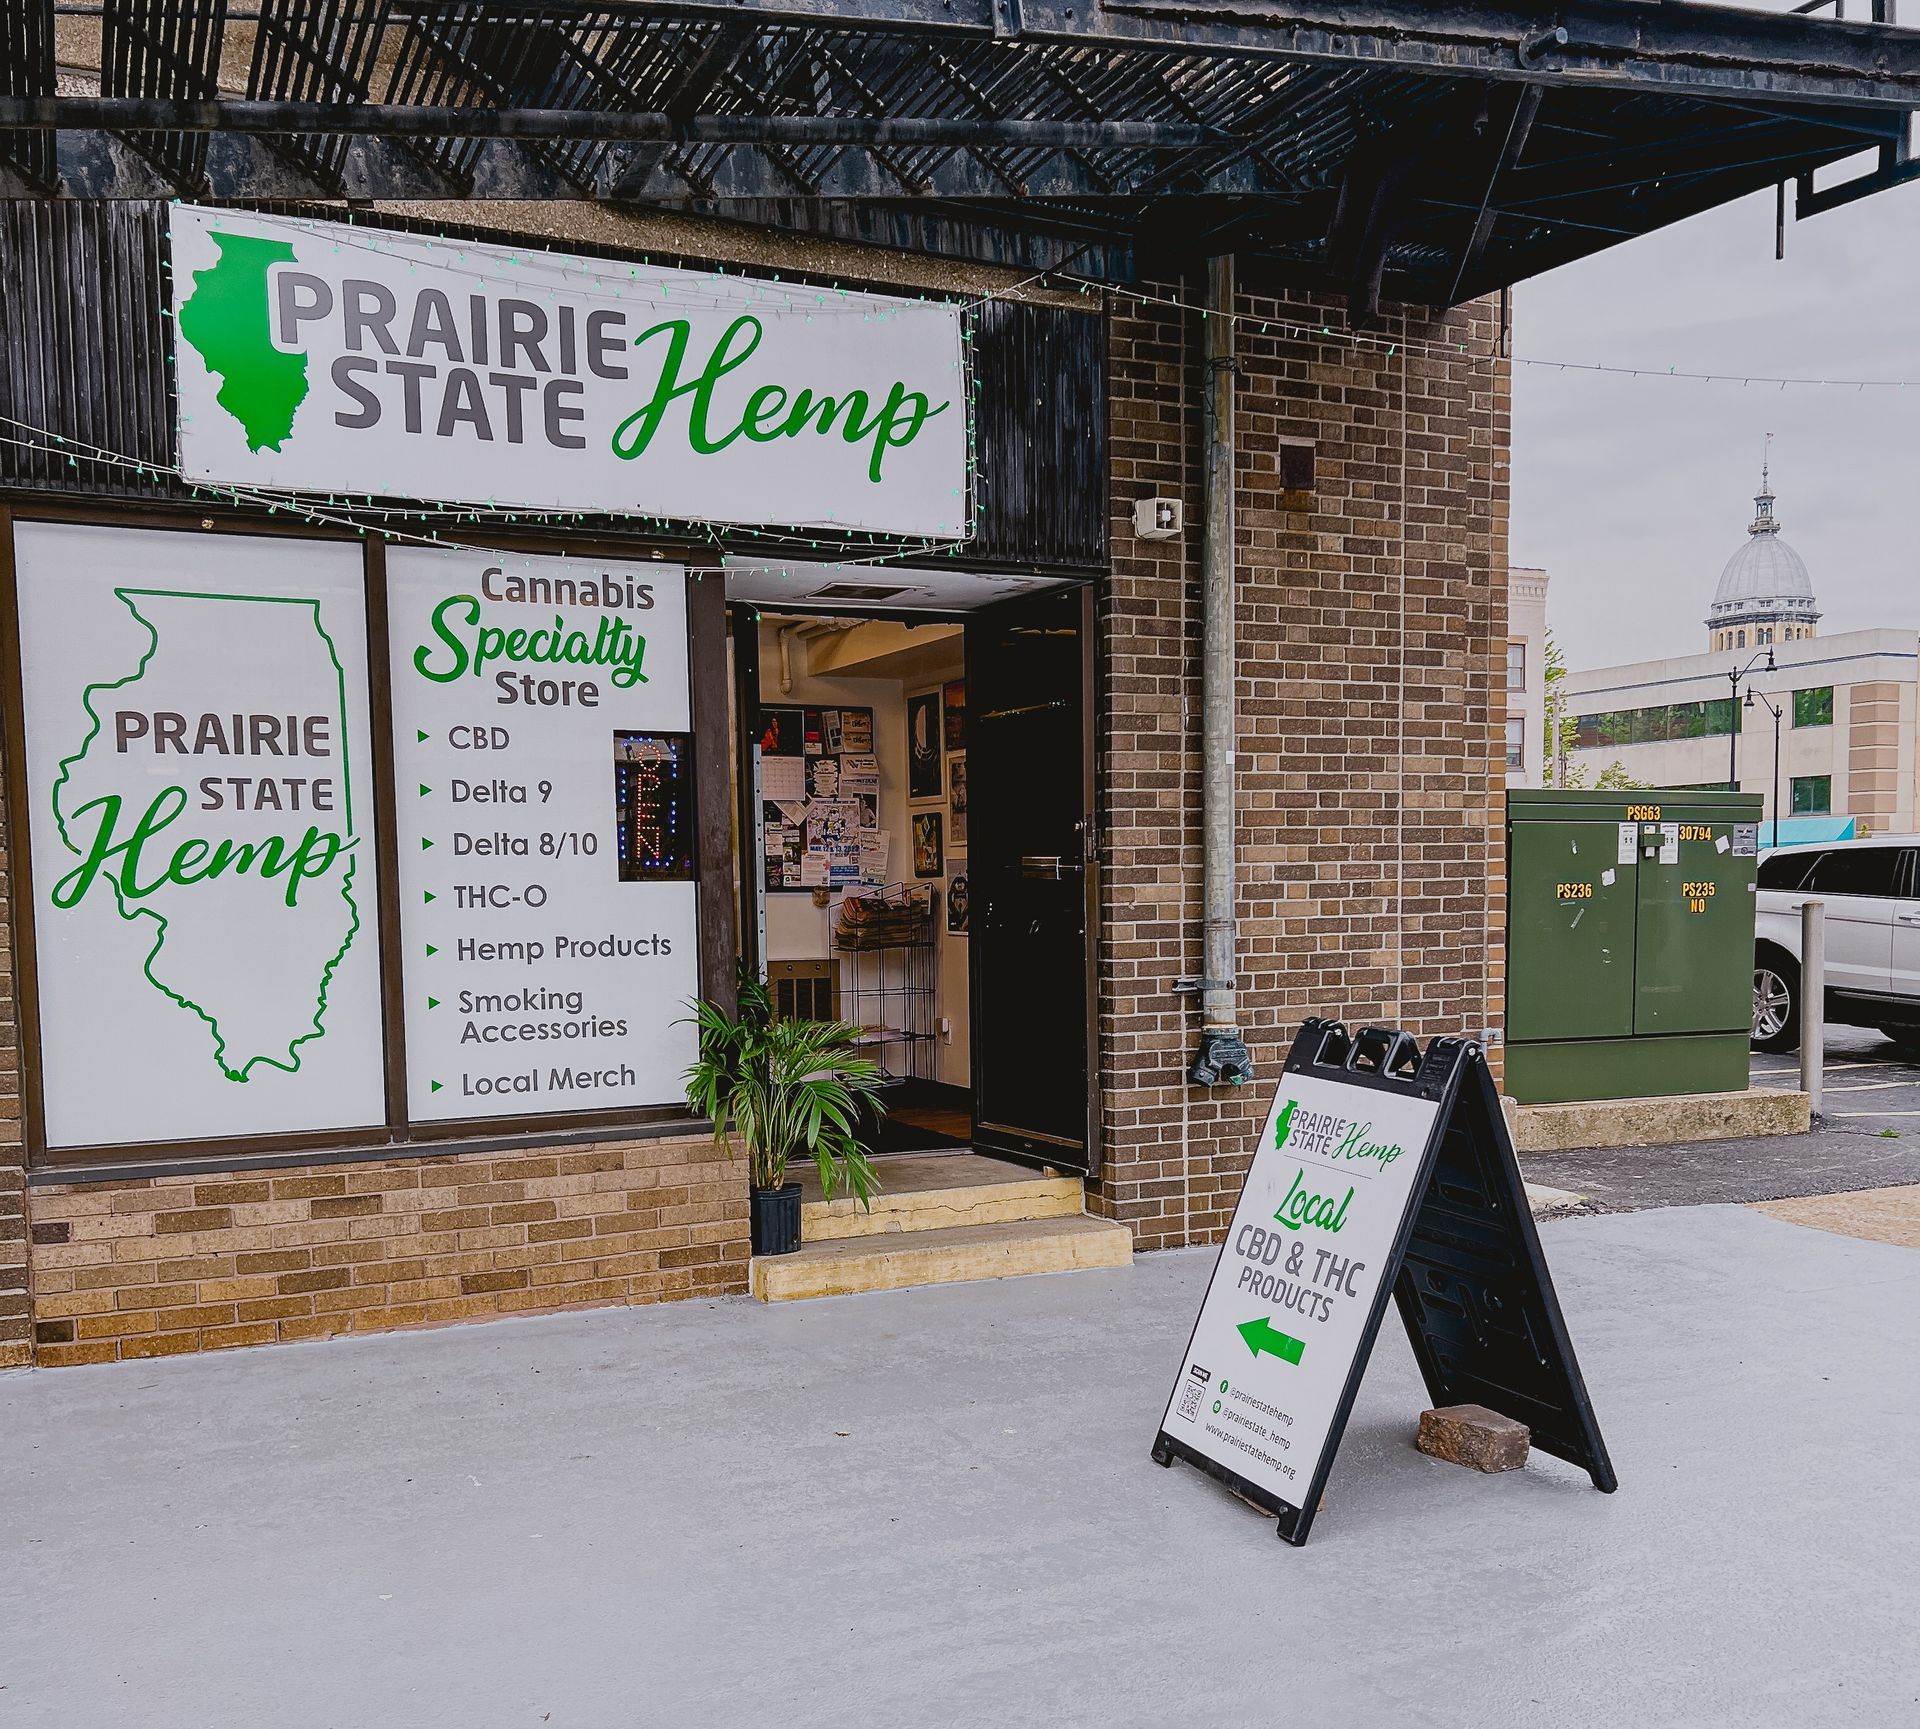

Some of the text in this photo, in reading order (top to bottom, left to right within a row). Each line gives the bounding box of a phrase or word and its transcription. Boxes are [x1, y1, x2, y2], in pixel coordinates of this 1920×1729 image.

[277, 271, 628, 380] PRAIRIE
[331, 355, 587, 450] STATE
[612, 315, 950, 483] Hemp
[481, 567, 655, 610] Cannabis
[413, 594, 650, 689] Specialty
[495, 670, 600, 708] Store
[115, 710, 331, 757] PRAIRIE
[448, 725, 510, 750] CBD
[199, 776, 334, 811] STATE
[451, 779, 553, 804] Delta 9
[637, 743, 662, 860] OPEN
[1627, 805, 1661, 821] PSG63
[51, 785, 361, 909] Hemp
[453, 831, 598, 860] Delta 8/10
[1679, 825, 1712, 841] 30794
[453, 884, 548, 909] THC-O
[1557, 883, 1592, 899] PS236
[1682, 882, 1716, 897] PS235
[1691, 899, 1706, 913] NO
[457, 933, 672, 966] Hemp Products
[458, 986, 583, 1015] Smoking
[460, 1015, 628, 1045] Accessories
[462, 1063, 636, 1097] Local Merch
[1288, 1108, 1347, 1138] PRAIRIE
[1289, 1129, 1333, 1156] STATE
[1331, 1121, 1406, 1173] Hemp
[1273, 1168, 1355, 1233] Local
[1235, 1224, 1366, 1298] CBD & THC
[1237, 1265, 1334, 1323] PRODUCTS
[1230, 1387, 1294, 1427] @prairiestatehemp
[1223, 1407, 1291, 1452] @prairiestate_hemp
[1205, 1422, 1297, 1481] www.prairiestatehemp.org
